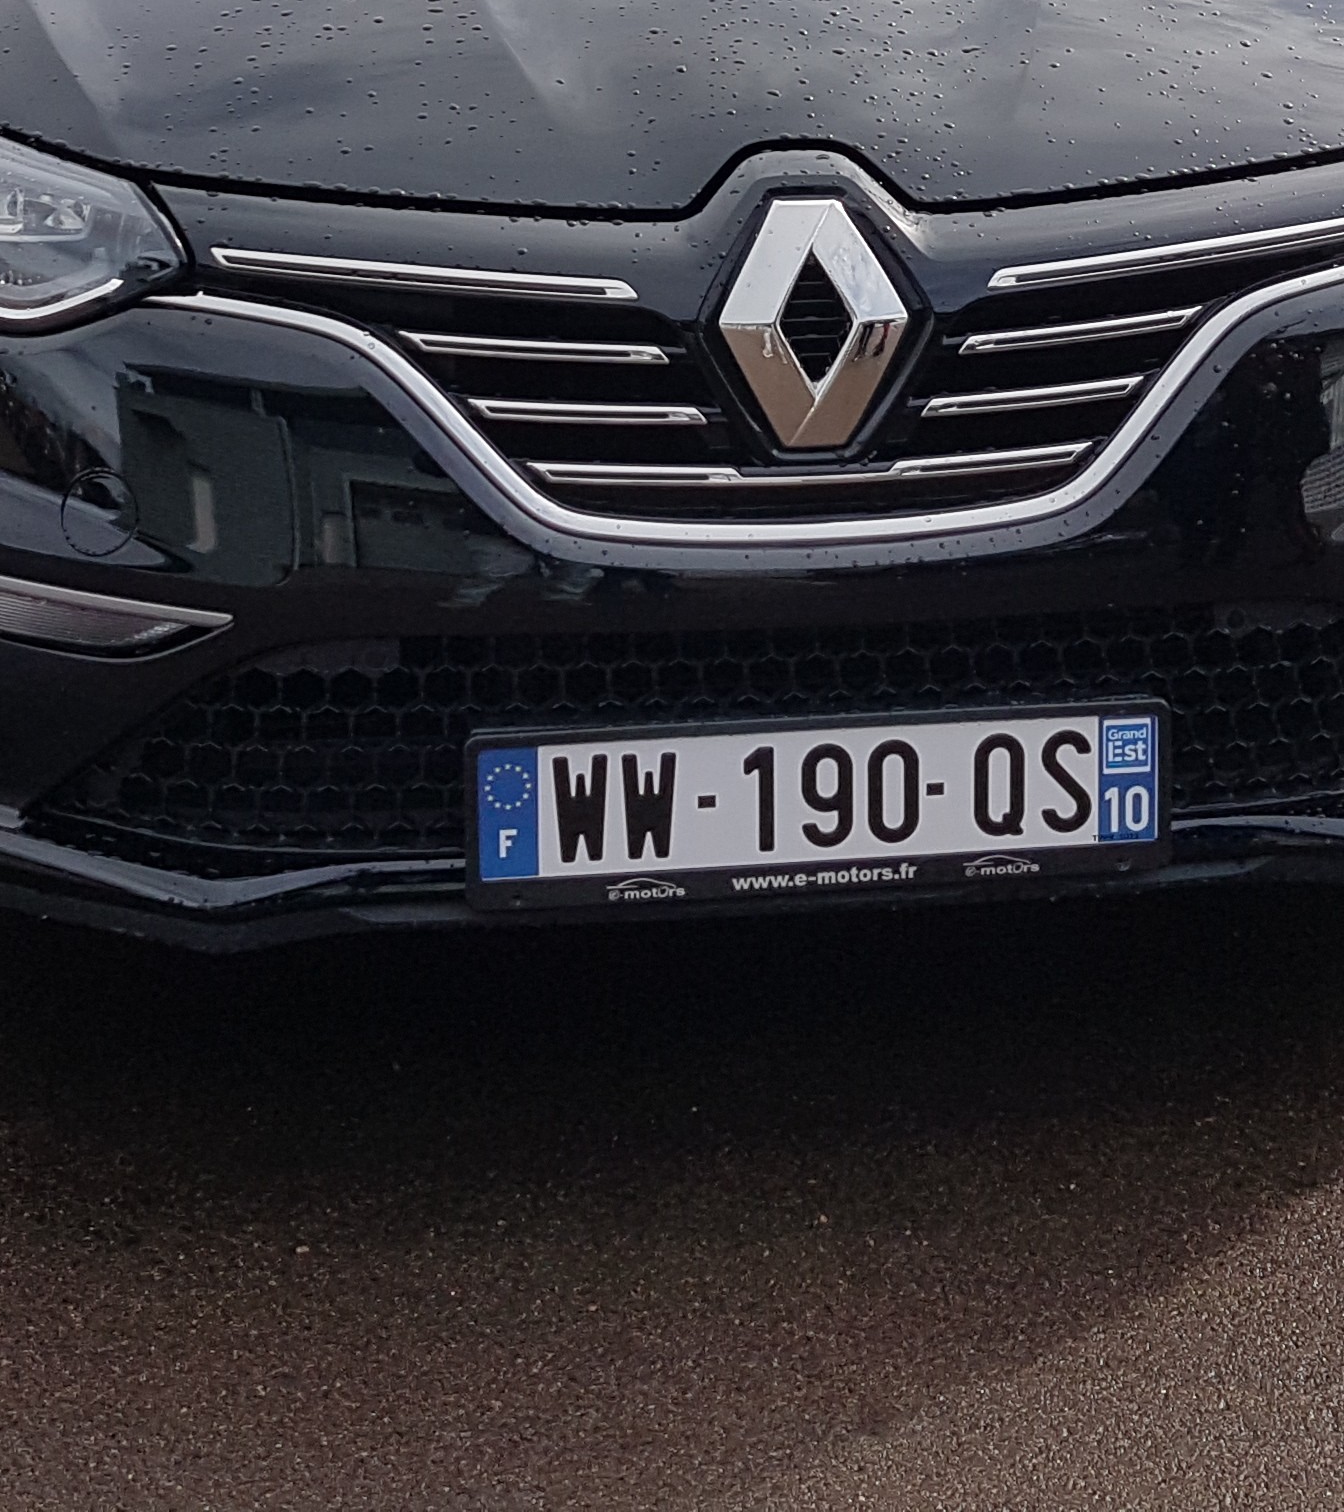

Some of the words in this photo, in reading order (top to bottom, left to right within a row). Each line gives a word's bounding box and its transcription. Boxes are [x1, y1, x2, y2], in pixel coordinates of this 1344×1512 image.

[1107, 727, 1147, 741] Grand
[1107, 740, 1147, 762] Est
[1104, 785, 1150, 833] 10
[499, 828, 518, 858] F
[731, 863, 918, 891] www.e-motors.fr
